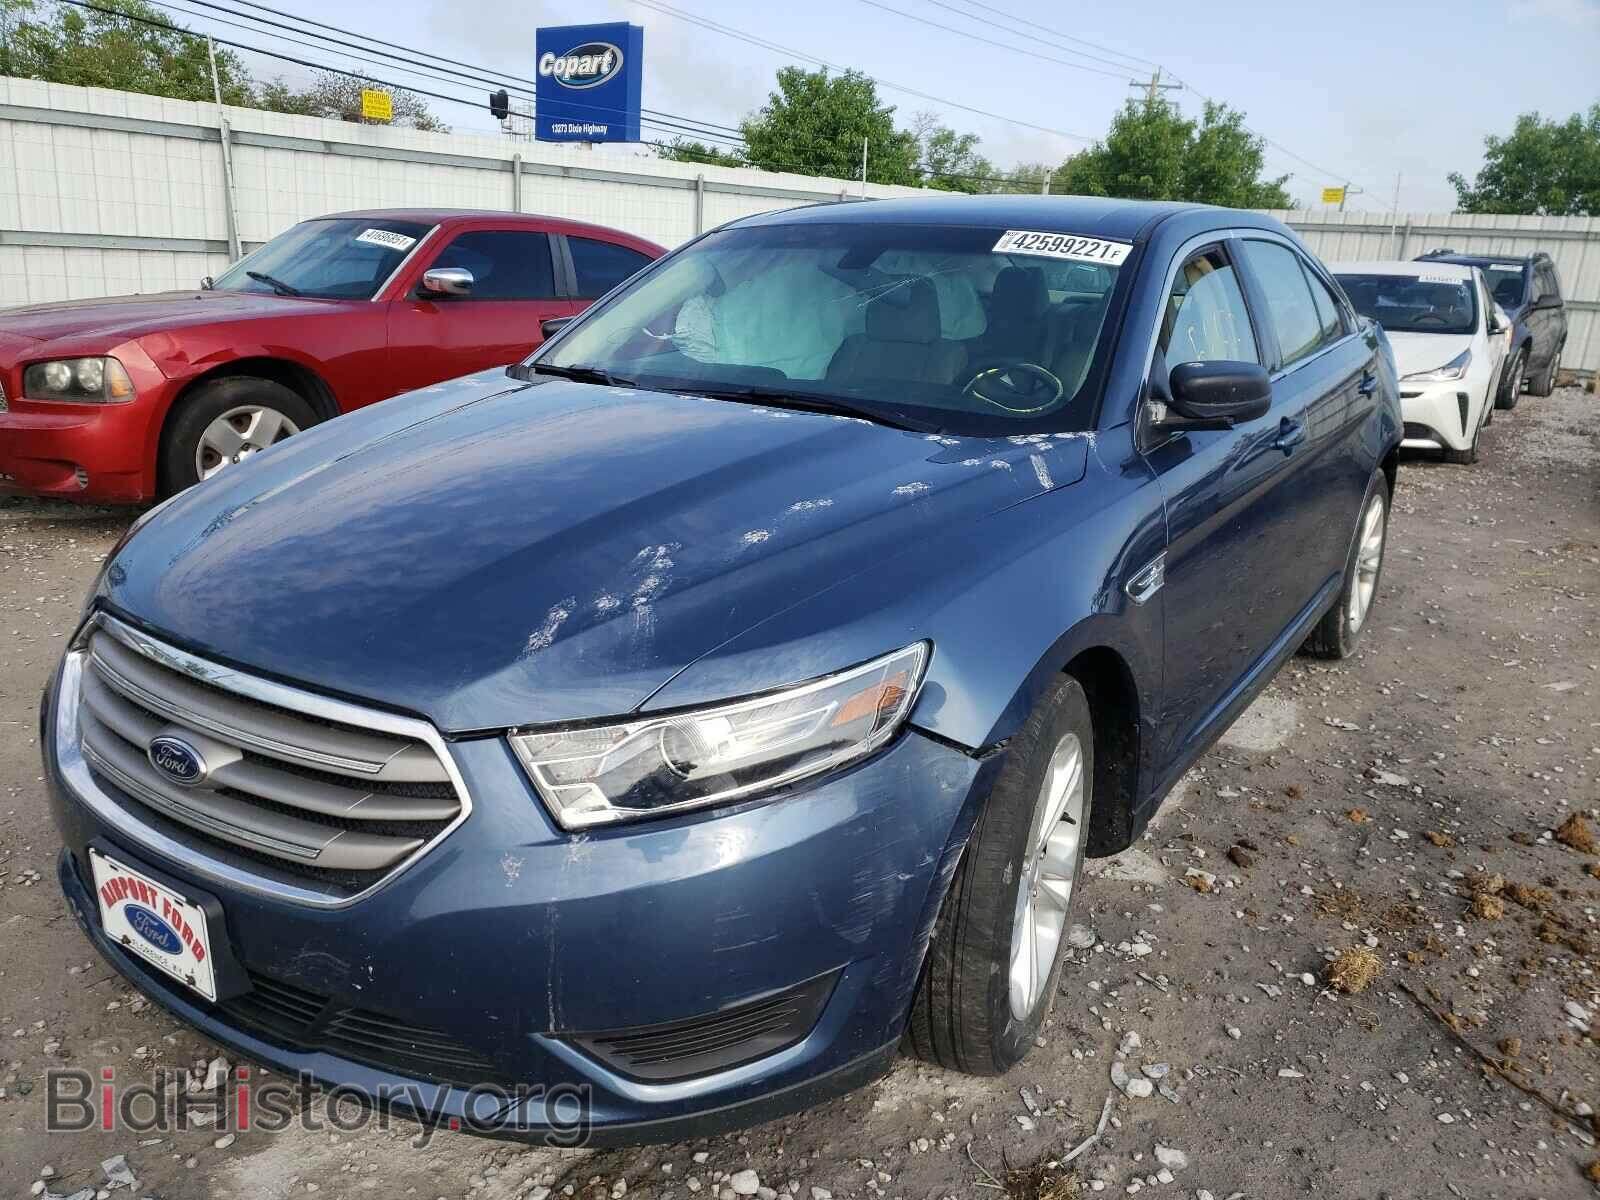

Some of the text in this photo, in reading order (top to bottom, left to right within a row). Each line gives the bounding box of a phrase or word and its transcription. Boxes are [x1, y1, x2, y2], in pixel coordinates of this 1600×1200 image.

[539, 48, 613, 80] Copart
[551, 122, 608, 135] 13273 Dixie Highway
[1012, 232, 1111, 259] 42599221
[156, 745, 190, 774] Ford
[100, 876, 206, 962] AIRPORT FORD
[134, 911, 169, 947] Ford
